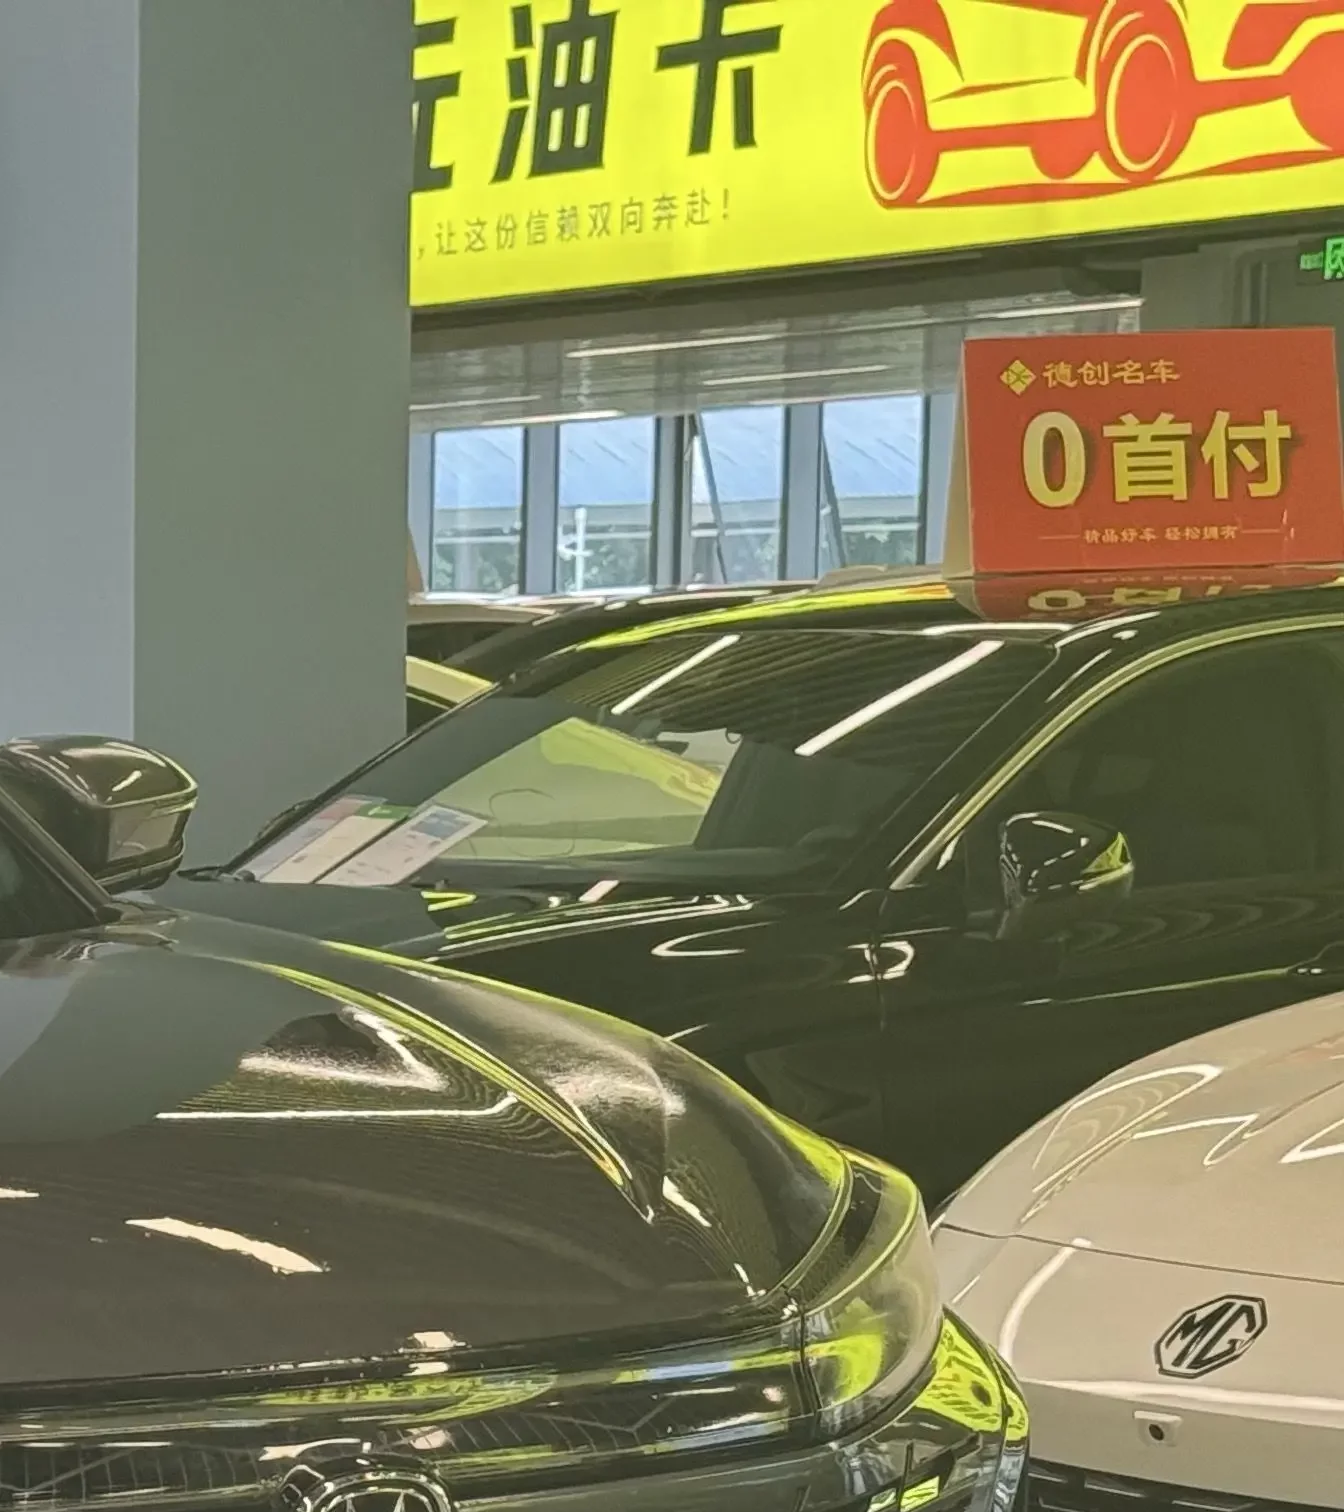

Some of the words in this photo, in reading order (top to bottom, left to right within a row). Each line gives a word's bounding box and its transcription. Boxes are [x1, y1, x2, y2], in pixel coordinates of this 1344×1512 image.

[1042, 359, 1180, 389] 德创名车
[1023, 409, 1292, 508] 0首付
[1164, 1300, 1257, 1370] MG
